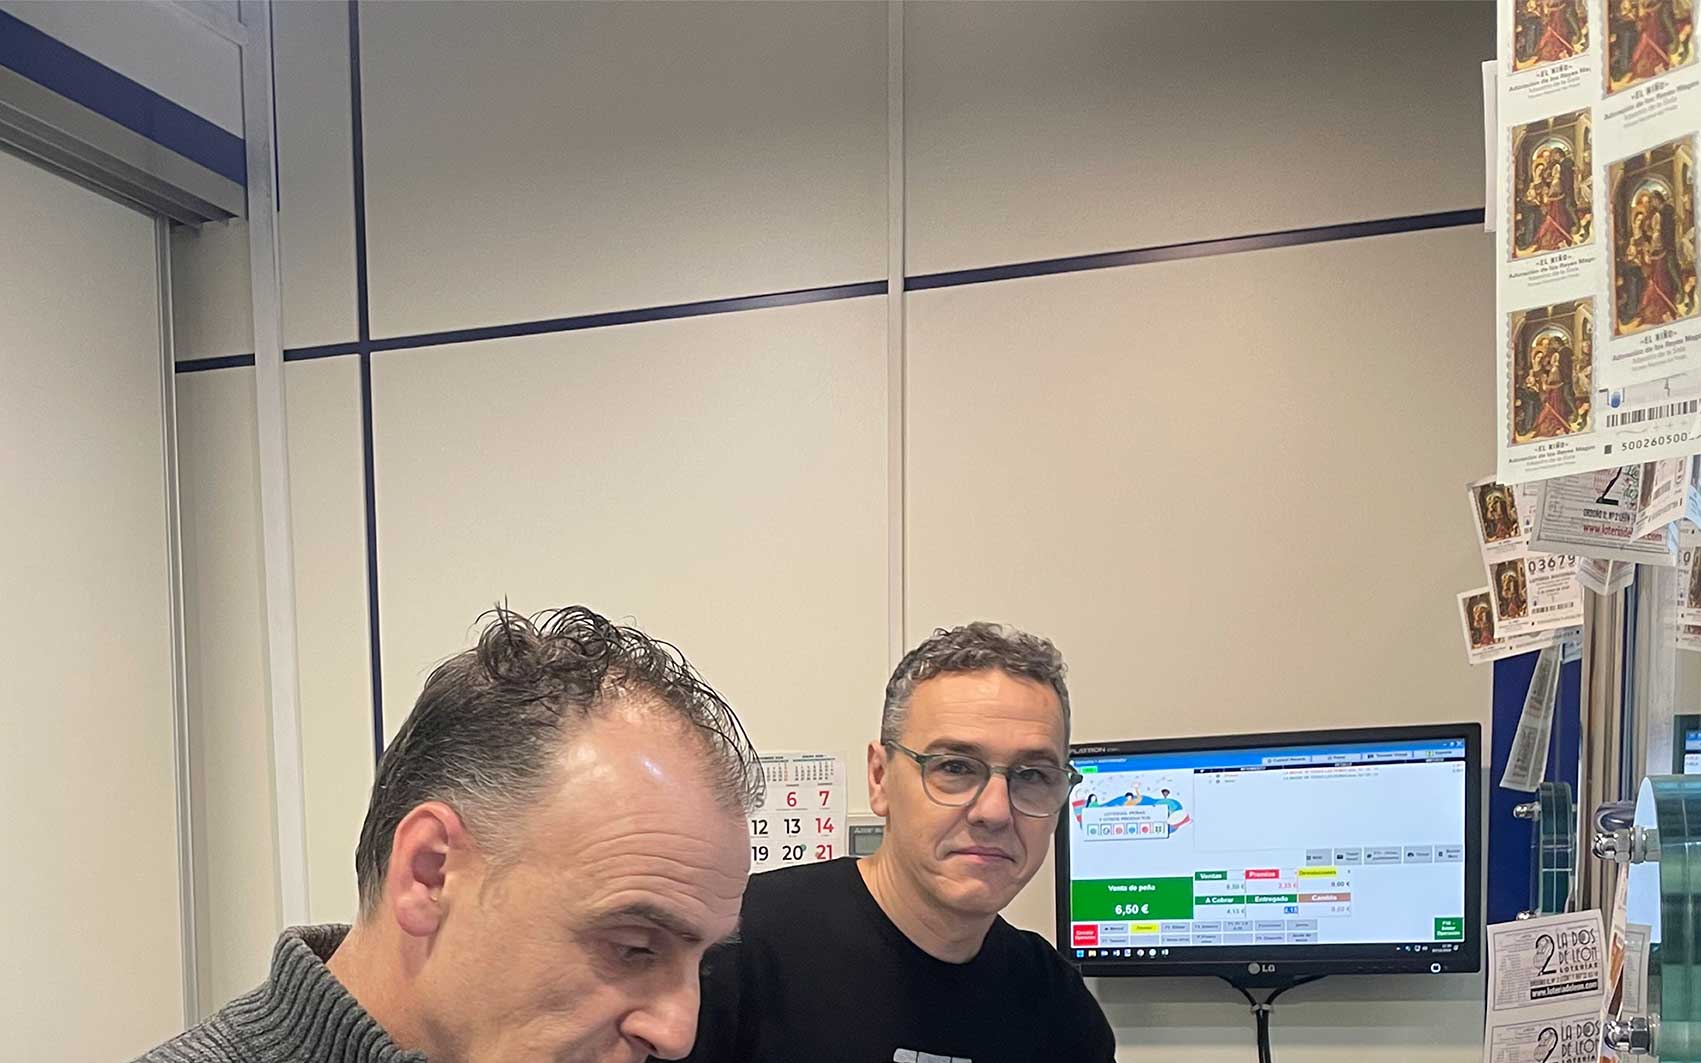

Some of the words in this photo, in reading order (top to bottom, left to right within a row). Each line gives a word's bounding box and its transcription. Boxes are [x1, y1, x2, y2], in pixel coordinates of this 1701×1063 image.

[786, 791, 798, 808] 6
[819, 790, 831, 807] 7
[751, 819, 769, 835] 12
[783, 818, 801, 834] 13
[815, 817, 835, 834] 14
[751, 846, 769, 861] 19
[782, 845, 803, 861] 20
[816, 844, 833, 860] 21
[1115, 904, 1139, 916] 6,50
[1557, 932, 1568, 949] LA
[1572, 928, 1596, 946] DOS
[1535, 933, 1557, 977] 2
[1559, 950, 1569, 965] DE
[1262, 964, 1276, 973] LG
[1561, 1025, 1572, 1041] LA
[1577, 1020, 1600, 1039] DOS
[1562, 1042, 1572, 1057] DE
